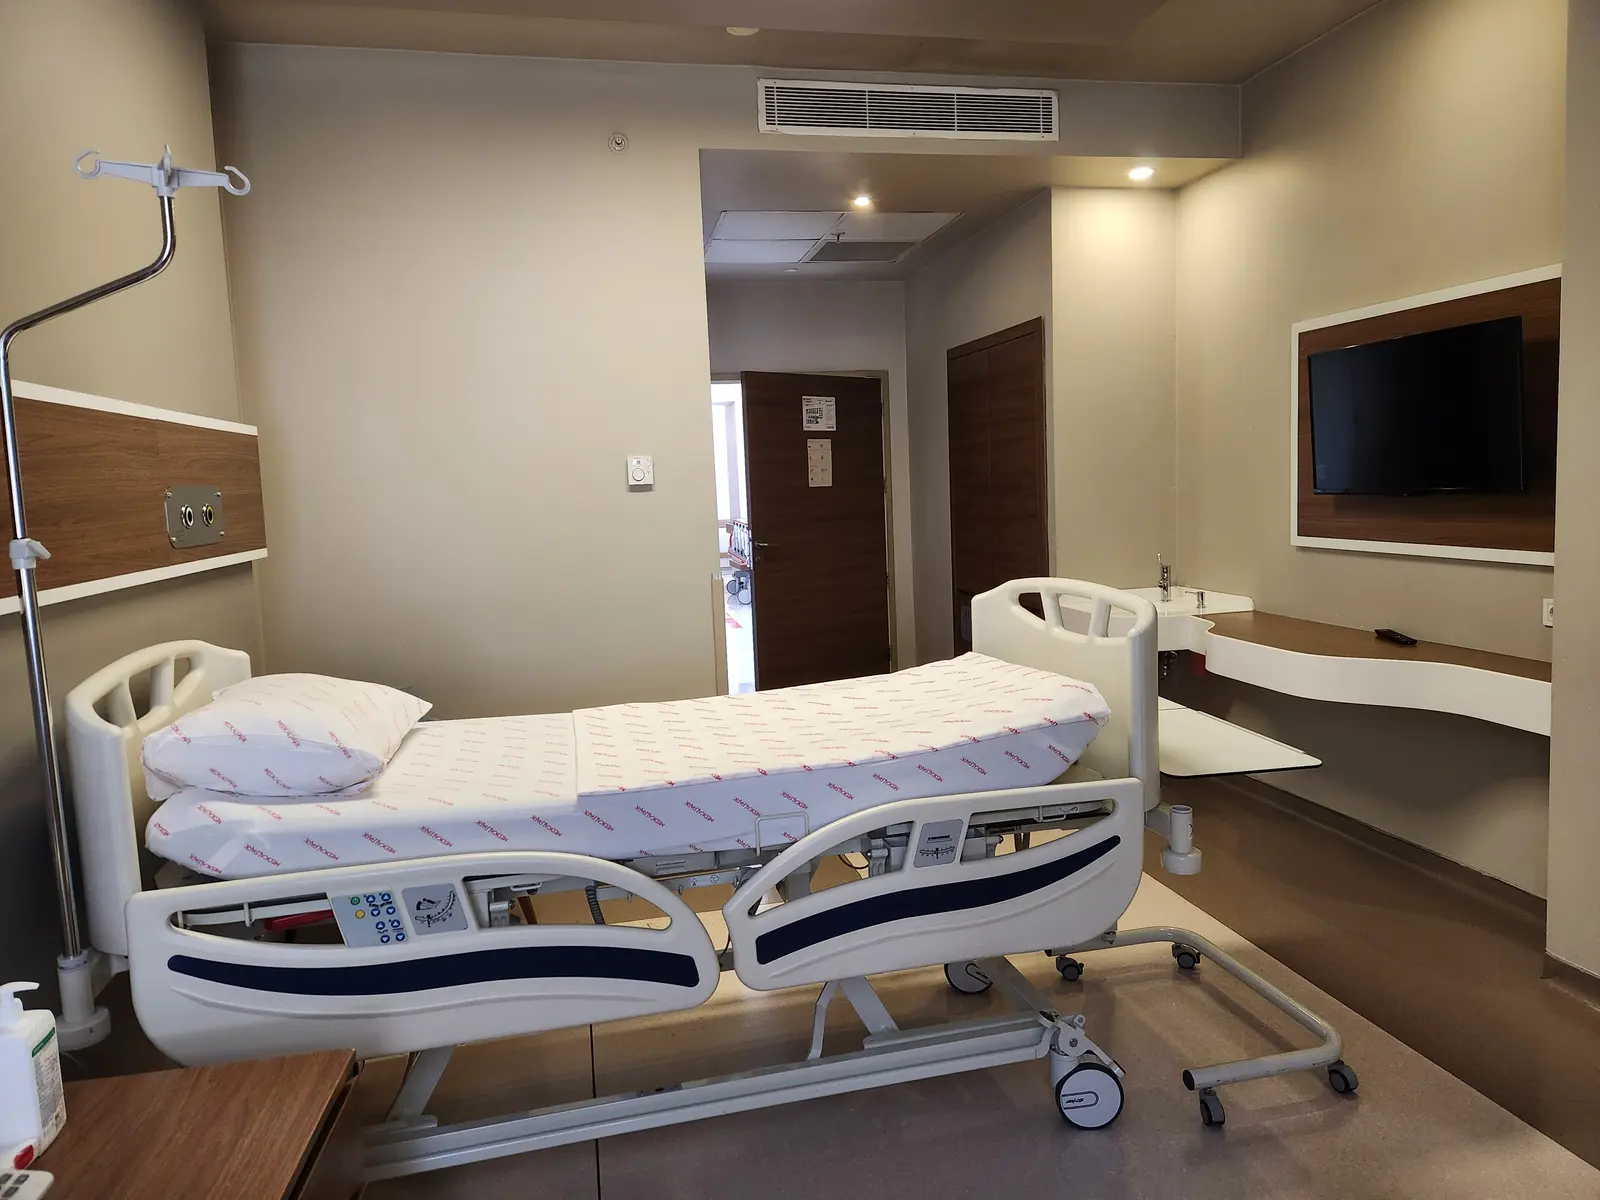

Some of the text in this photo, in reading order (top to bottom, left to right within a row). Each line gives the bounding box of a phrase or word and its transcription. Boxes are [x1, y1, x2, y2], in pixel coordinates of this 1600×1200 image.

[959, 758, 987, 776] MEDICALPARK
[1003, 750, 1030, 770] MEDICALPARK
[874, 774, 901, 791] MEDICALPARK
[916, 763, 943, 783] MEDICALPARK
[780, 790, 807, 810] MEDICALPARK
[828, 781, 855, 800] MEDICALPARK
[635, 804, 666, 827] MEDICALPARK
[685, 800, 713, 823] MEDICALPARK
[734, 797, 762, 817] MEDICALPARK
[475, 819, 510, 842] MEDICALPARK
[530, 815, 562, 838] MEDICALPARK
[584, 809, 614, 833] MEDICALPARK
[362, 832, 399, 858] MEDICALPARK
[419, 825, 453, 848] MEDICALPARK
[244, 844, 281, 868] MEDICALPARK
[304, 838, 340, 863] MEDICALPARK
[188, 854, 222, 874] MEDICALPARK
